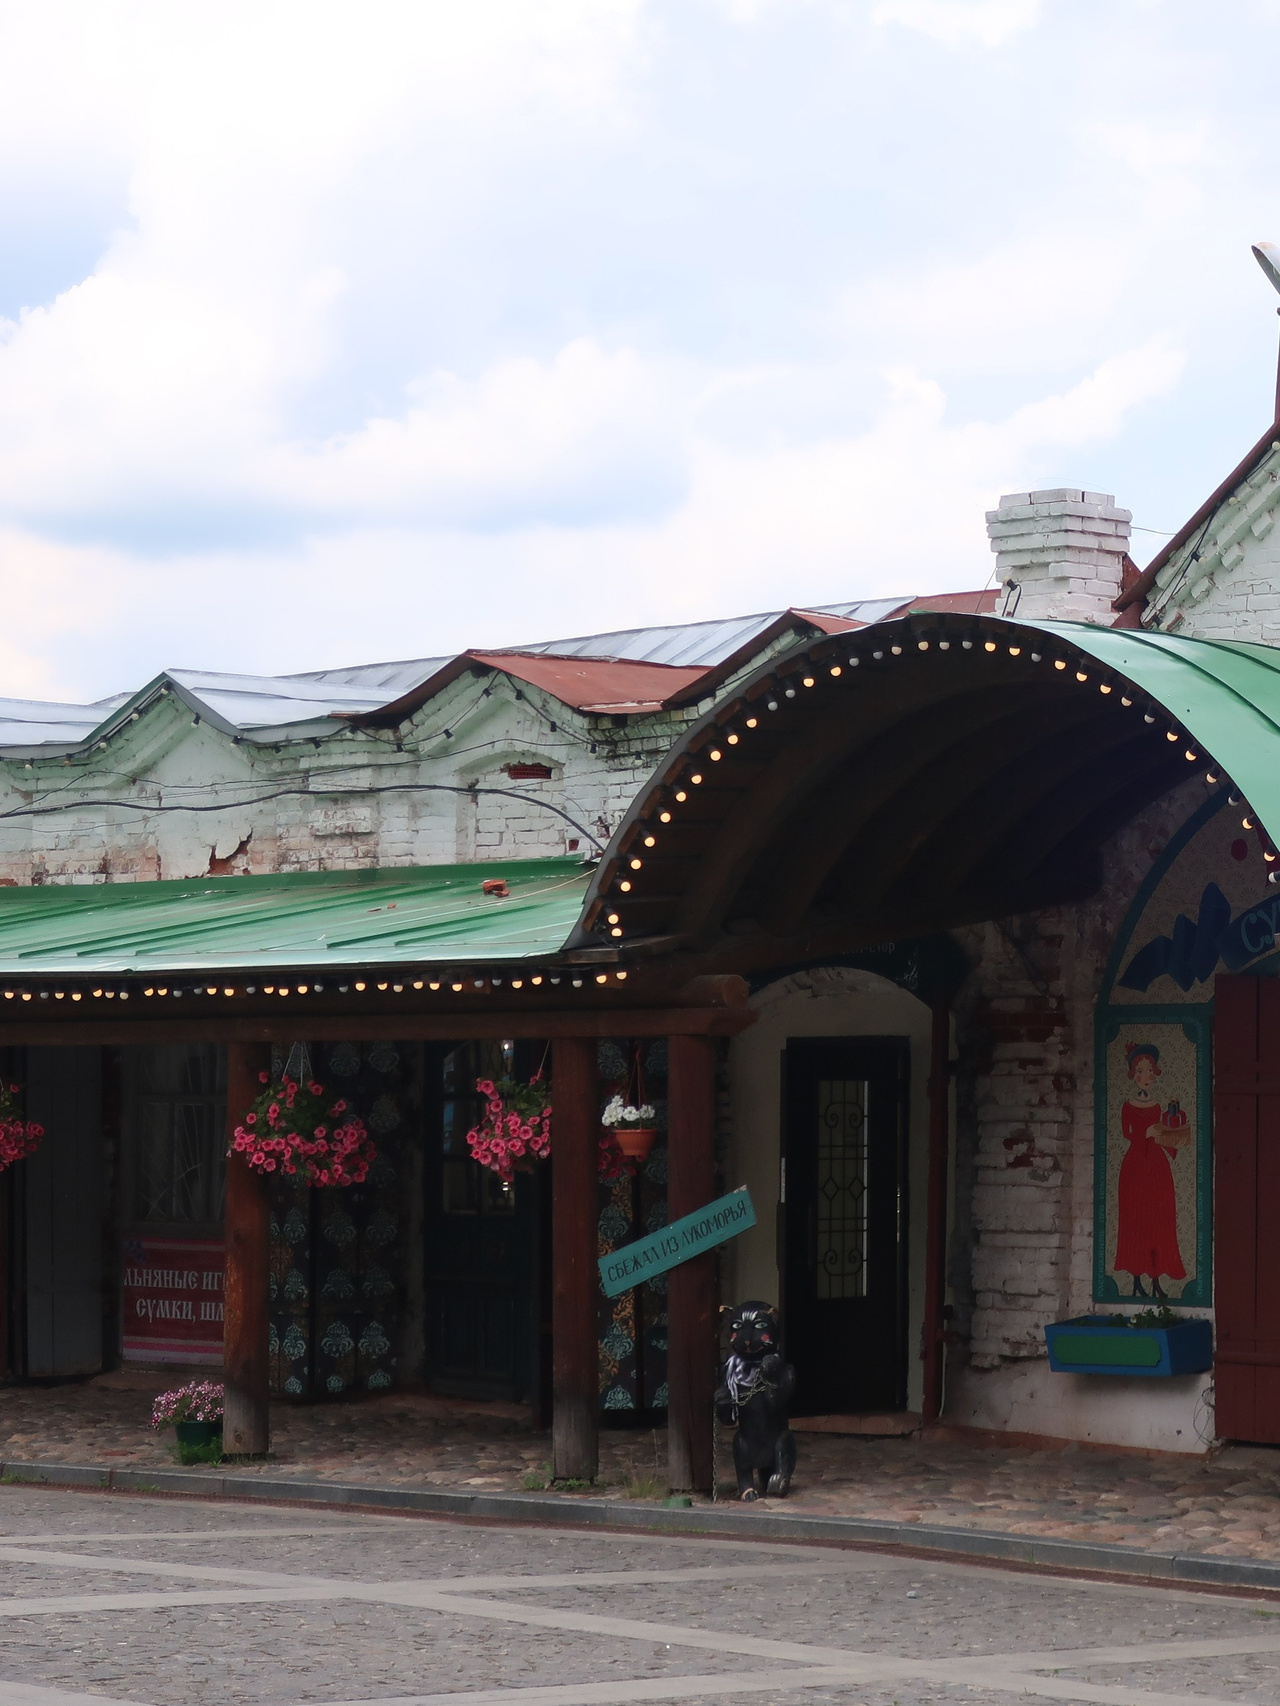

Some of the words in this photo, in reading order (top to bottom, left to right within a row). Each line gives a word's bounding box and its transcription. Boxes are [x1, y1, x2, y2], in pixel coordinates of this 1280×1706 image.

[607, 1246, 660, 1282] СБЕЖАЛ
[661, 1236, 680, 1257] ИЗ
[682, 1200, 747, 1248] ЛУКОМОРЬЯ
[124, 1268, 199, 1290] ЛЬНЯНЫЕ
[136, 1298, 196, 1323] СУМКИ,
